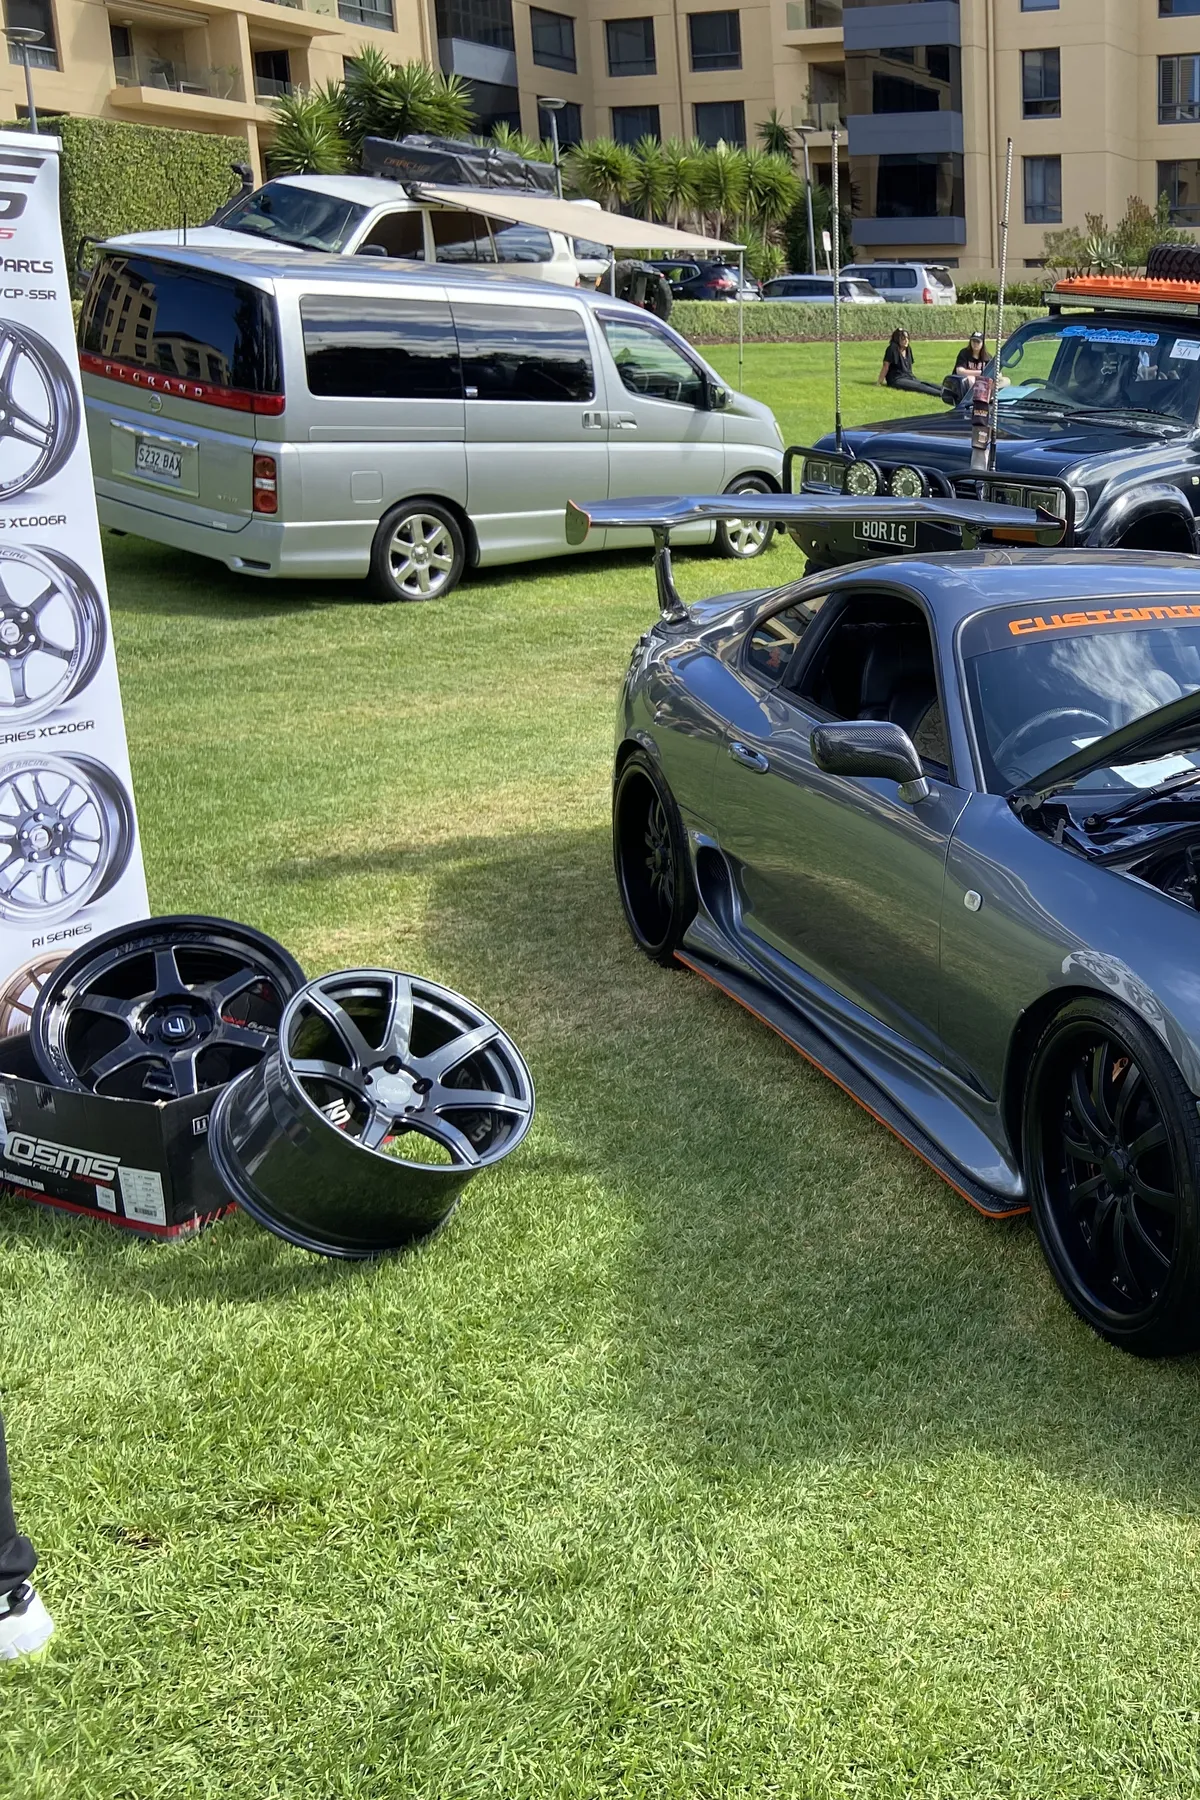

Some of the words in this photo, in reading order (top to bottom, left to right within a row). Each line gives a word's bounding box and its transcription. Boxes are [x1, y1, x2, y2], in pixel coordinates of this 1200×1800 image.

[105, 364, 204, 397] ELGRAND
[139, 448, 160, 470] S232
[163, 452, 182, 475] BAX
[46, 922, 93, 943] SERIES
[3, 1131, 121, 1182] COSMIS
[32, 1162, 70, 1179] racing
